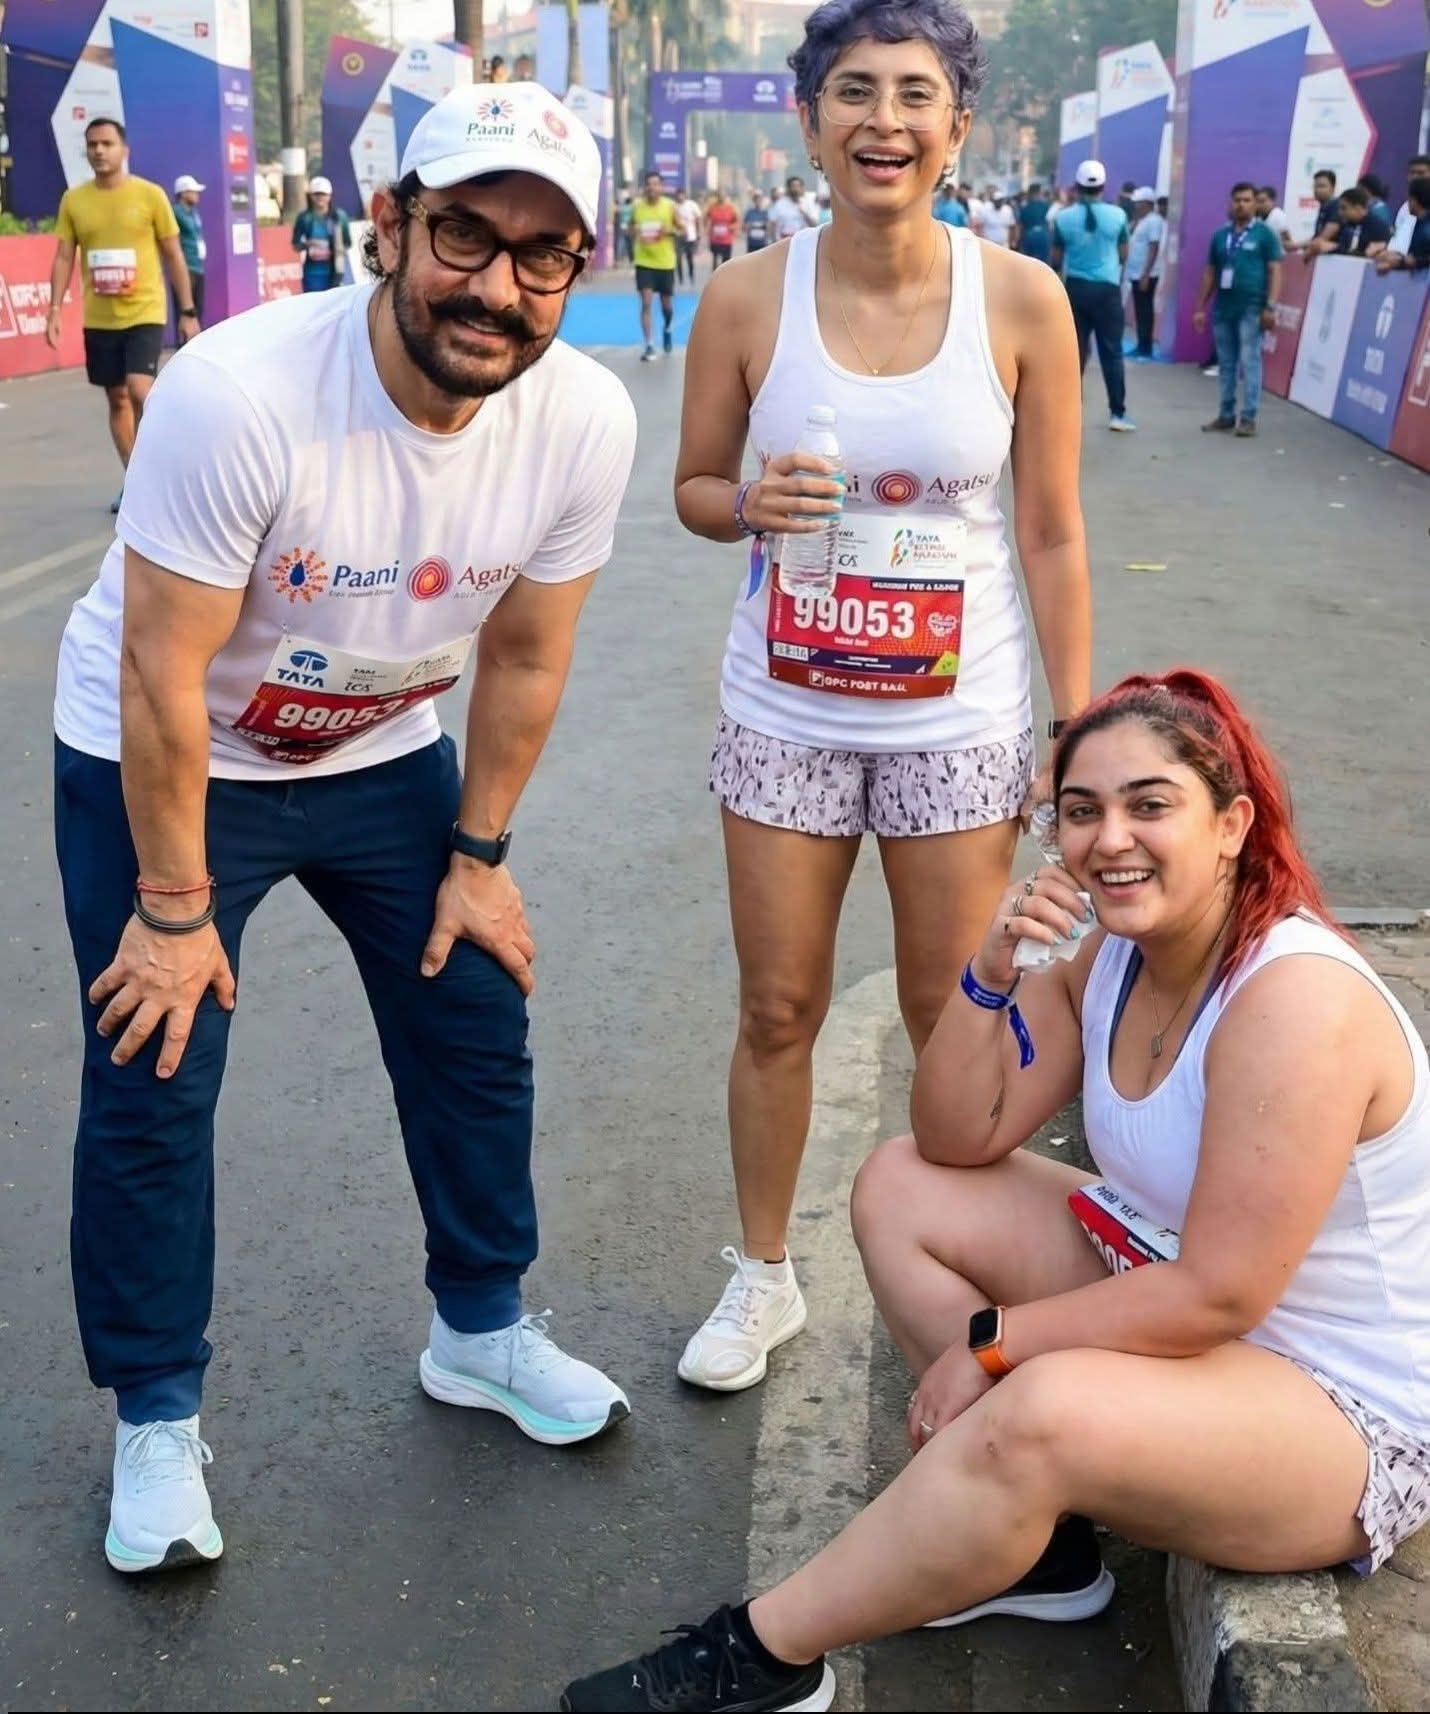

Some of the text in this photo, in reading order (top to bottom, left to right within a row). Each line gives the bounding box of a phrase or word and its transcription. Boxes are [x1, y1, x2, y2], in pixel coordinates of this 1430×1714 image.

[467, 123, 516, 137] Paani
[333, 560, 400, 588] Paani
[793, 592, 915, 639] 99053
[277, 667, 325, 689] TATA
